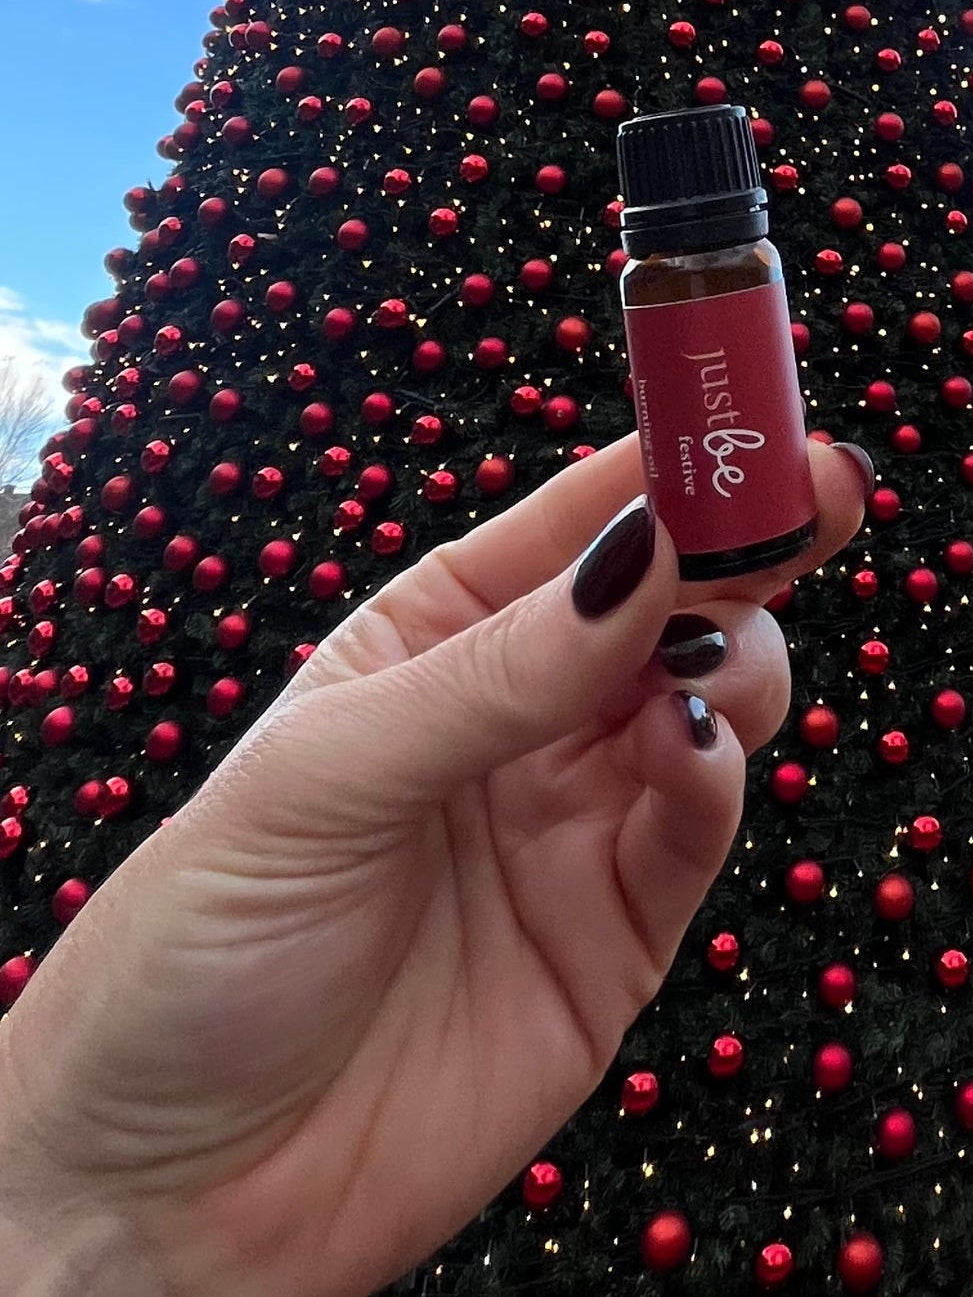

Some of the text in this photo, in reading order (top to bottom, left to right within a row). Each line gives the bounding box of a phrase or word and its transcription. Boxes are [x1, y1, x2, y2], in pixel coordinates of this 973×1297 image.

[682, 346, 766, 498] just be
[647, 455, 659, 478] oil
[678, 436, 696, 496] festive
